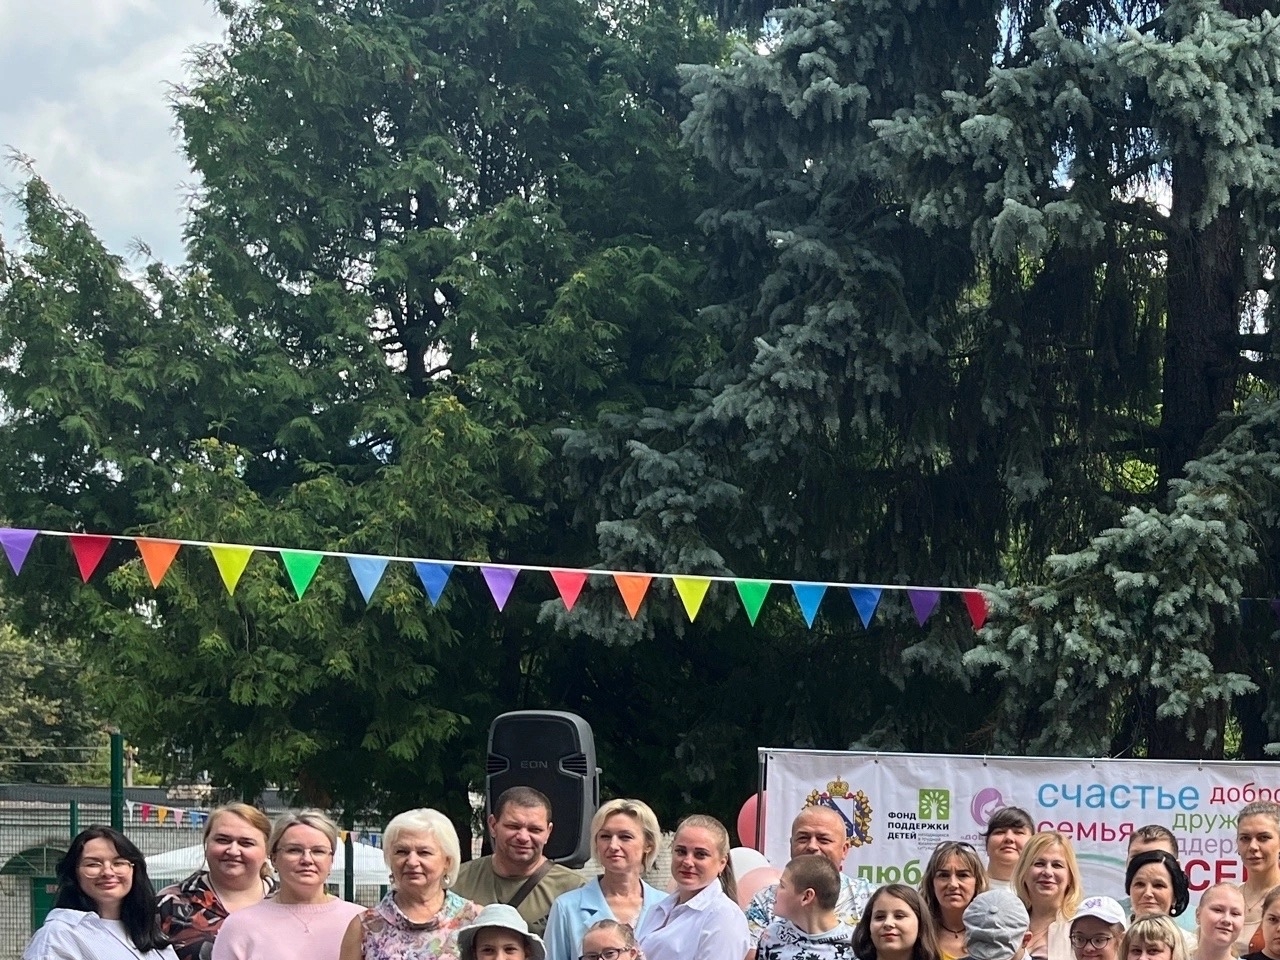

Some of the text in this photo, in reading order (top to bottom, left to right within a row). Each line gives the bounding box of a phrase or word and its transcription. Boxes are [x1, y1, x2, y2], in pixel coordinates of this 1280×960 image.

[520, 761, 548, 769] EON
[1038, 783, 1200, 811] счастье
[888, 811, 917, 821] ФОНД
[887, 822, 949, 831] ПОДДЕРЖКИ
[1172, 813, 1239, 834] друж
[887, 831, 917, 840] ДЕТЕЙ
[857, 859, 922, 885] люб
